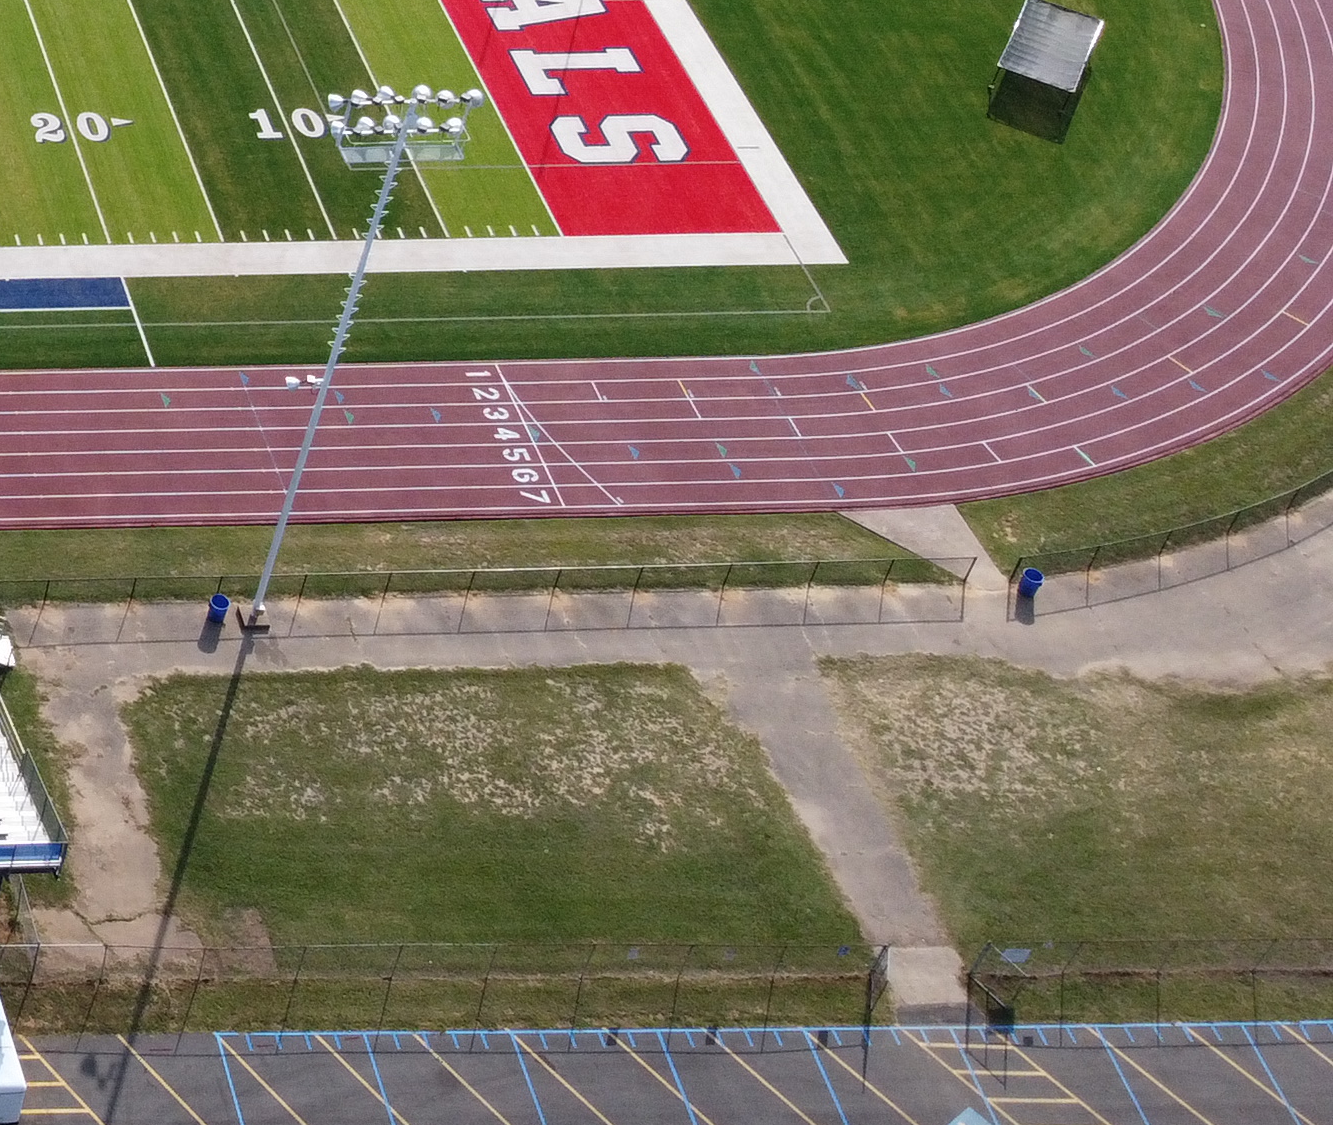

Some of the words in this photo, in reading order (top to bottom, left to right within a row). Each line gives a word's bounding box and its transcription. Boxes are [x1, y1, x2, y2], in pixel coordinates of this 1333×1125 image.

[31, 112, 109, 143] 20
[249, 108, 326, 139] 10
[472, 387, 500, 401] 2
[483, 407, 509, 420] 3
[493, 427, 520, 441] 4
[502, 447, 531, 461] 5
[511, 468, 539, 483] 6
[519, 489, 551, 504] 7
